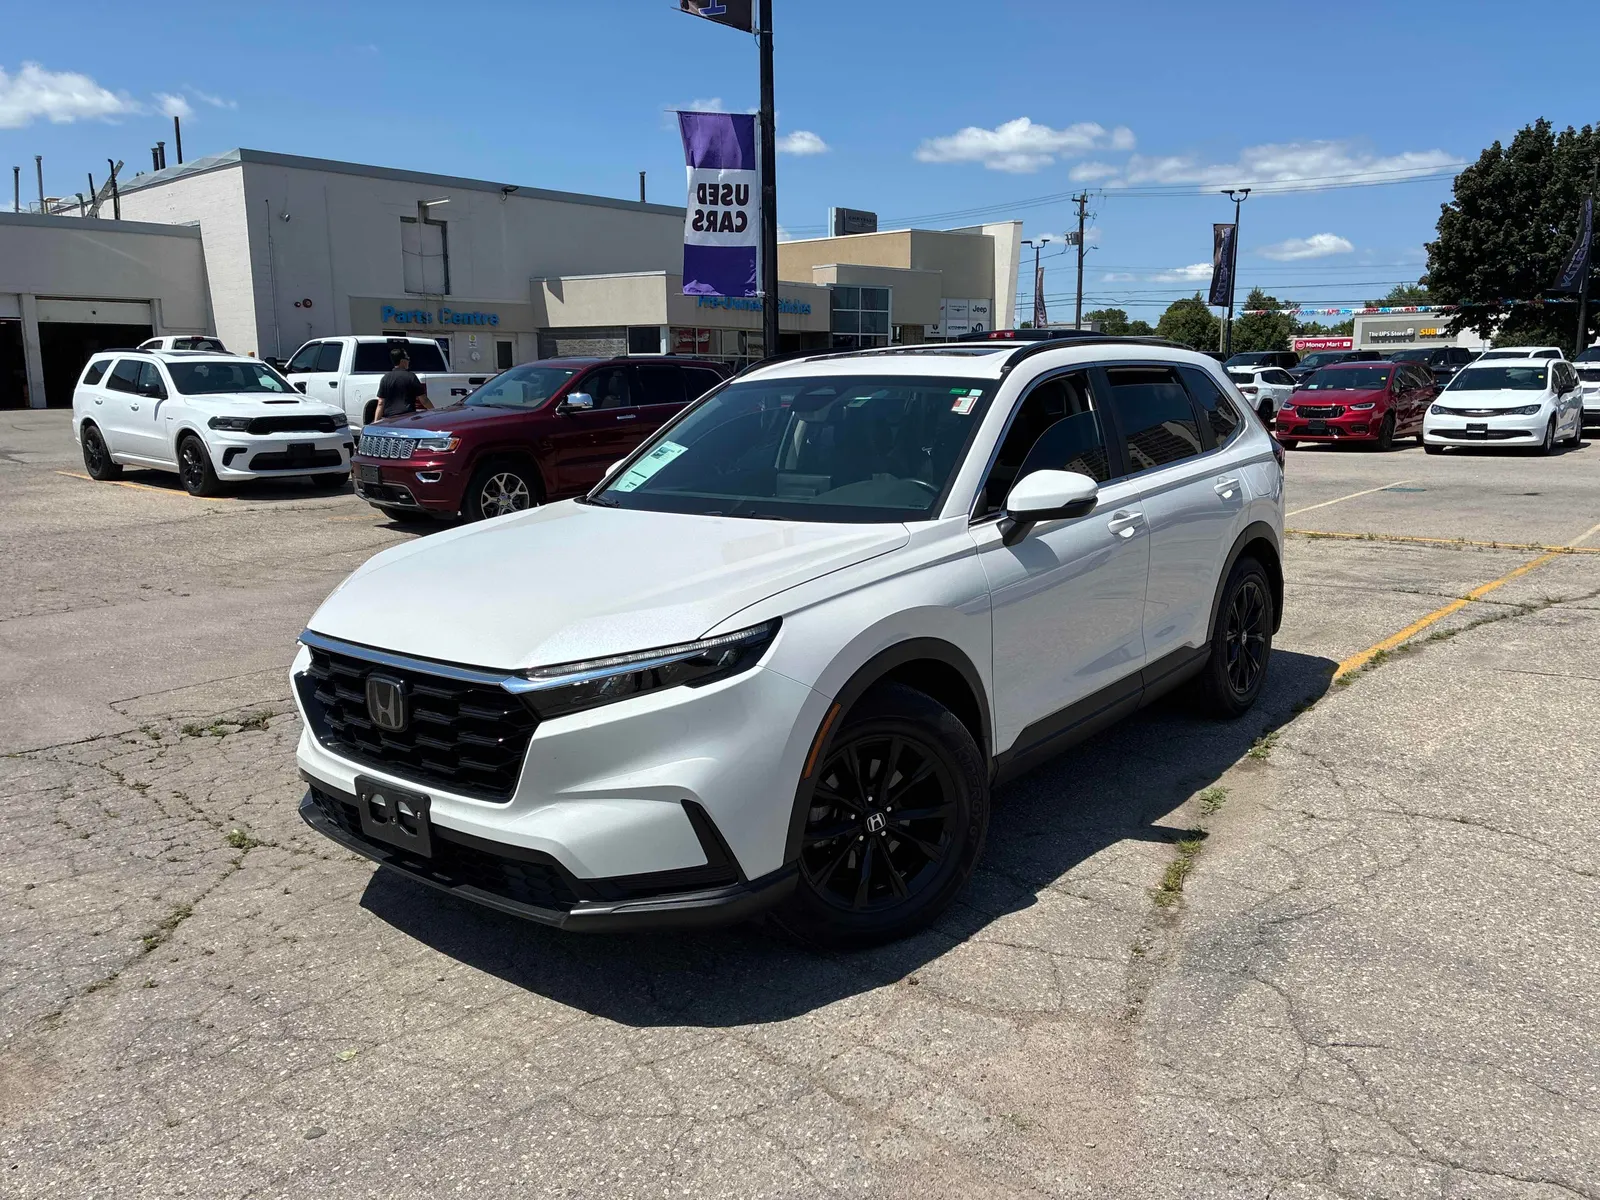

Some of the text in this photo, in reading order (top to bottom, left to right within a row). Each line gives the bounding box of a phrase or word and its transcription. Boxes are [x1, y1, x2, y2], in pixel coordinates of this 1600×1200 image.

[777, 300, 811, 314] hicles
[972, 305, 987, 313] Jeep
[382, 305, 499, 326] Parts Centre
[1419, 328, 1449, 336] SUBW
[450, 388, 504, 397] RM
